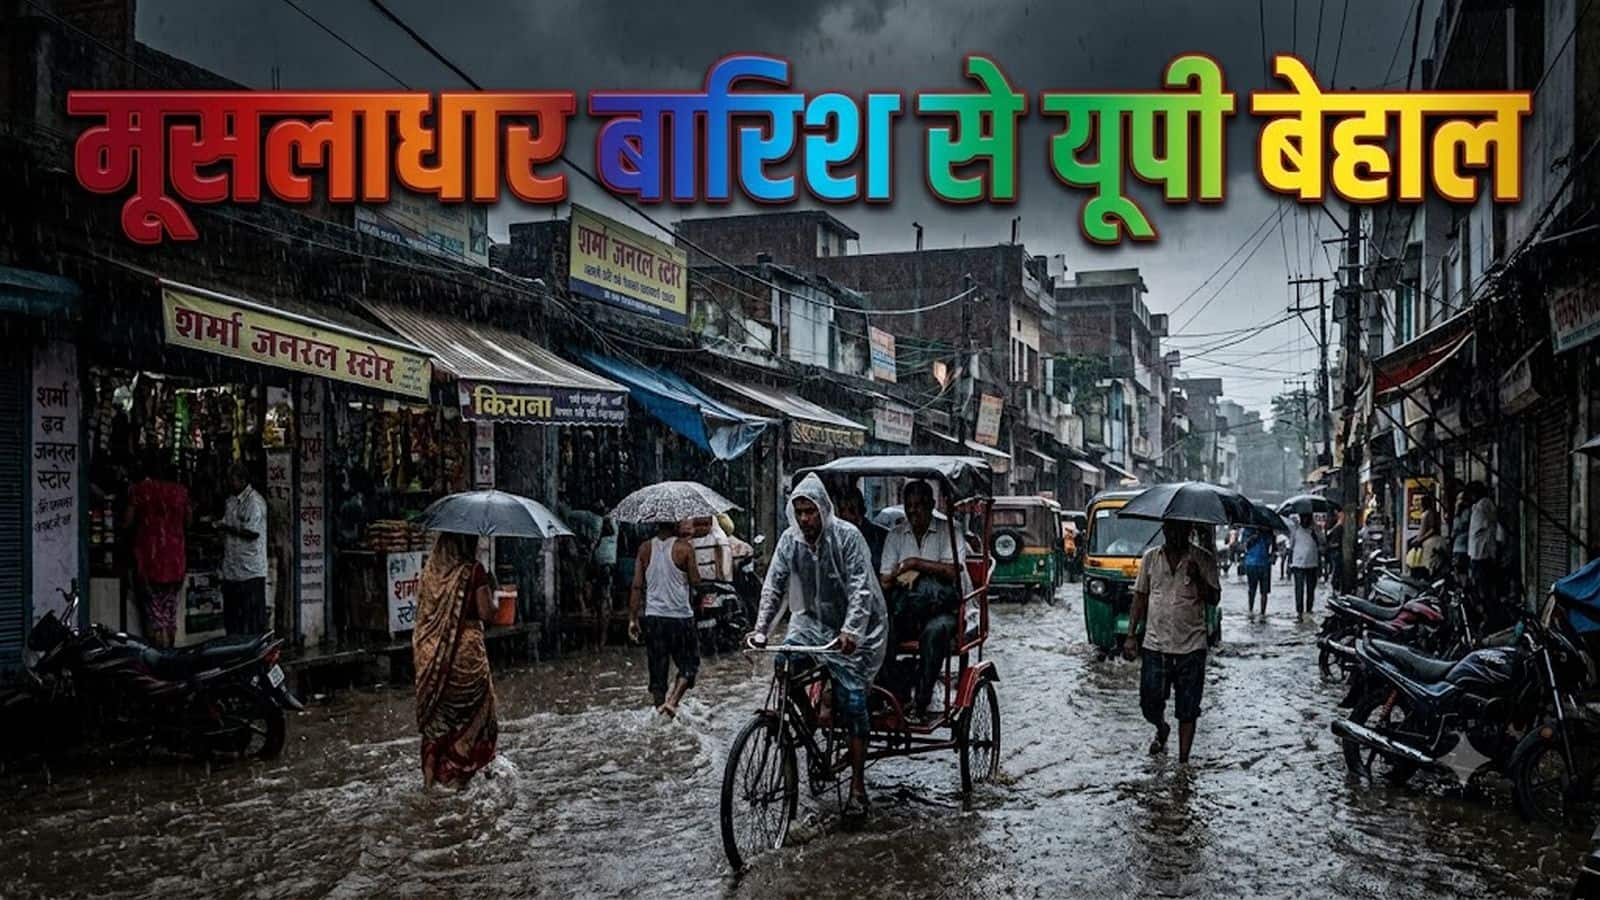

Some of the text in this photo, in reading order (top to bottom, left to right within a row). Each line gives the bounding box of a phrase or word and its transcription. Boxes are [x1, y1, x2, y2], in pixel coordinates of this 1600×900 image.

[174, 306, 243, 349] शर्मा
[346, 345, 397, 384] स्टोर
[36, 383, 70, 408] शर्मा
[473, 384, 554, 418] किराना
[33, 441, 78, 465] जनरल
[37, 464, 72, 490] स्टोर
